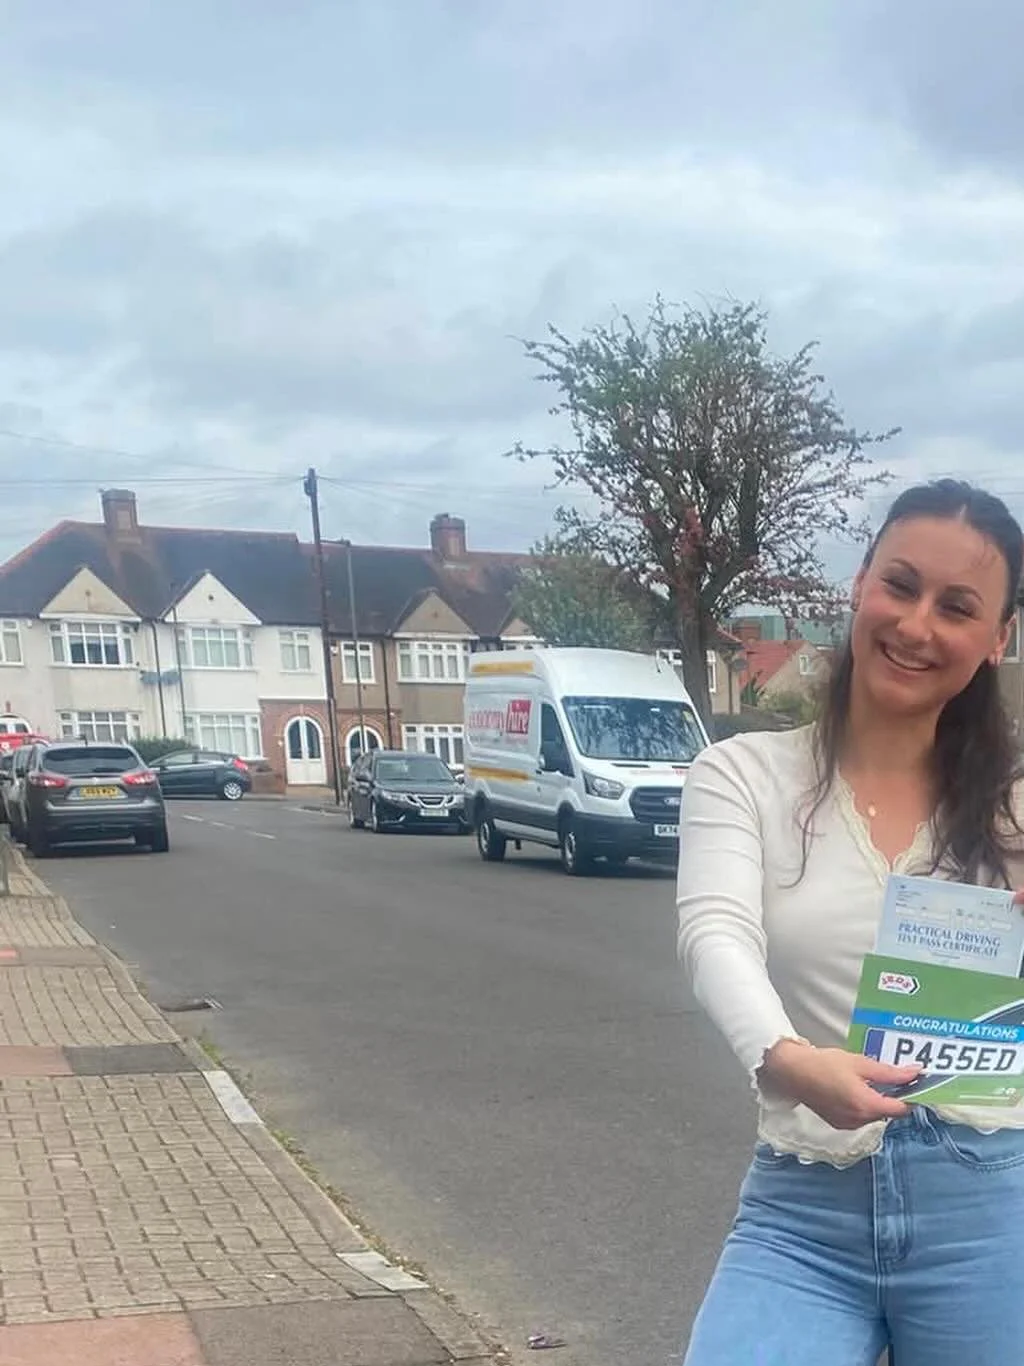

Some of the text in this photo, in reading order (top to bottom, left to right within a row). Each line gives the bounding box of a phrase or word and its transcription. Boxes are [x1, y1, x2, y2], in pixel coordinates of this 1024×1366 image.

[896, 933, 917, 945] TEST
[919, 936, 942, 950] PASS
[943, 939, 999, 957] CERTIFICATE
[898, 923, 1001, 947] PRACTICAL DRIVING
[893, 1014, 1019, 1040] CONGRATULATIONS
[894, 1037, 1018, 1072] P455ED
